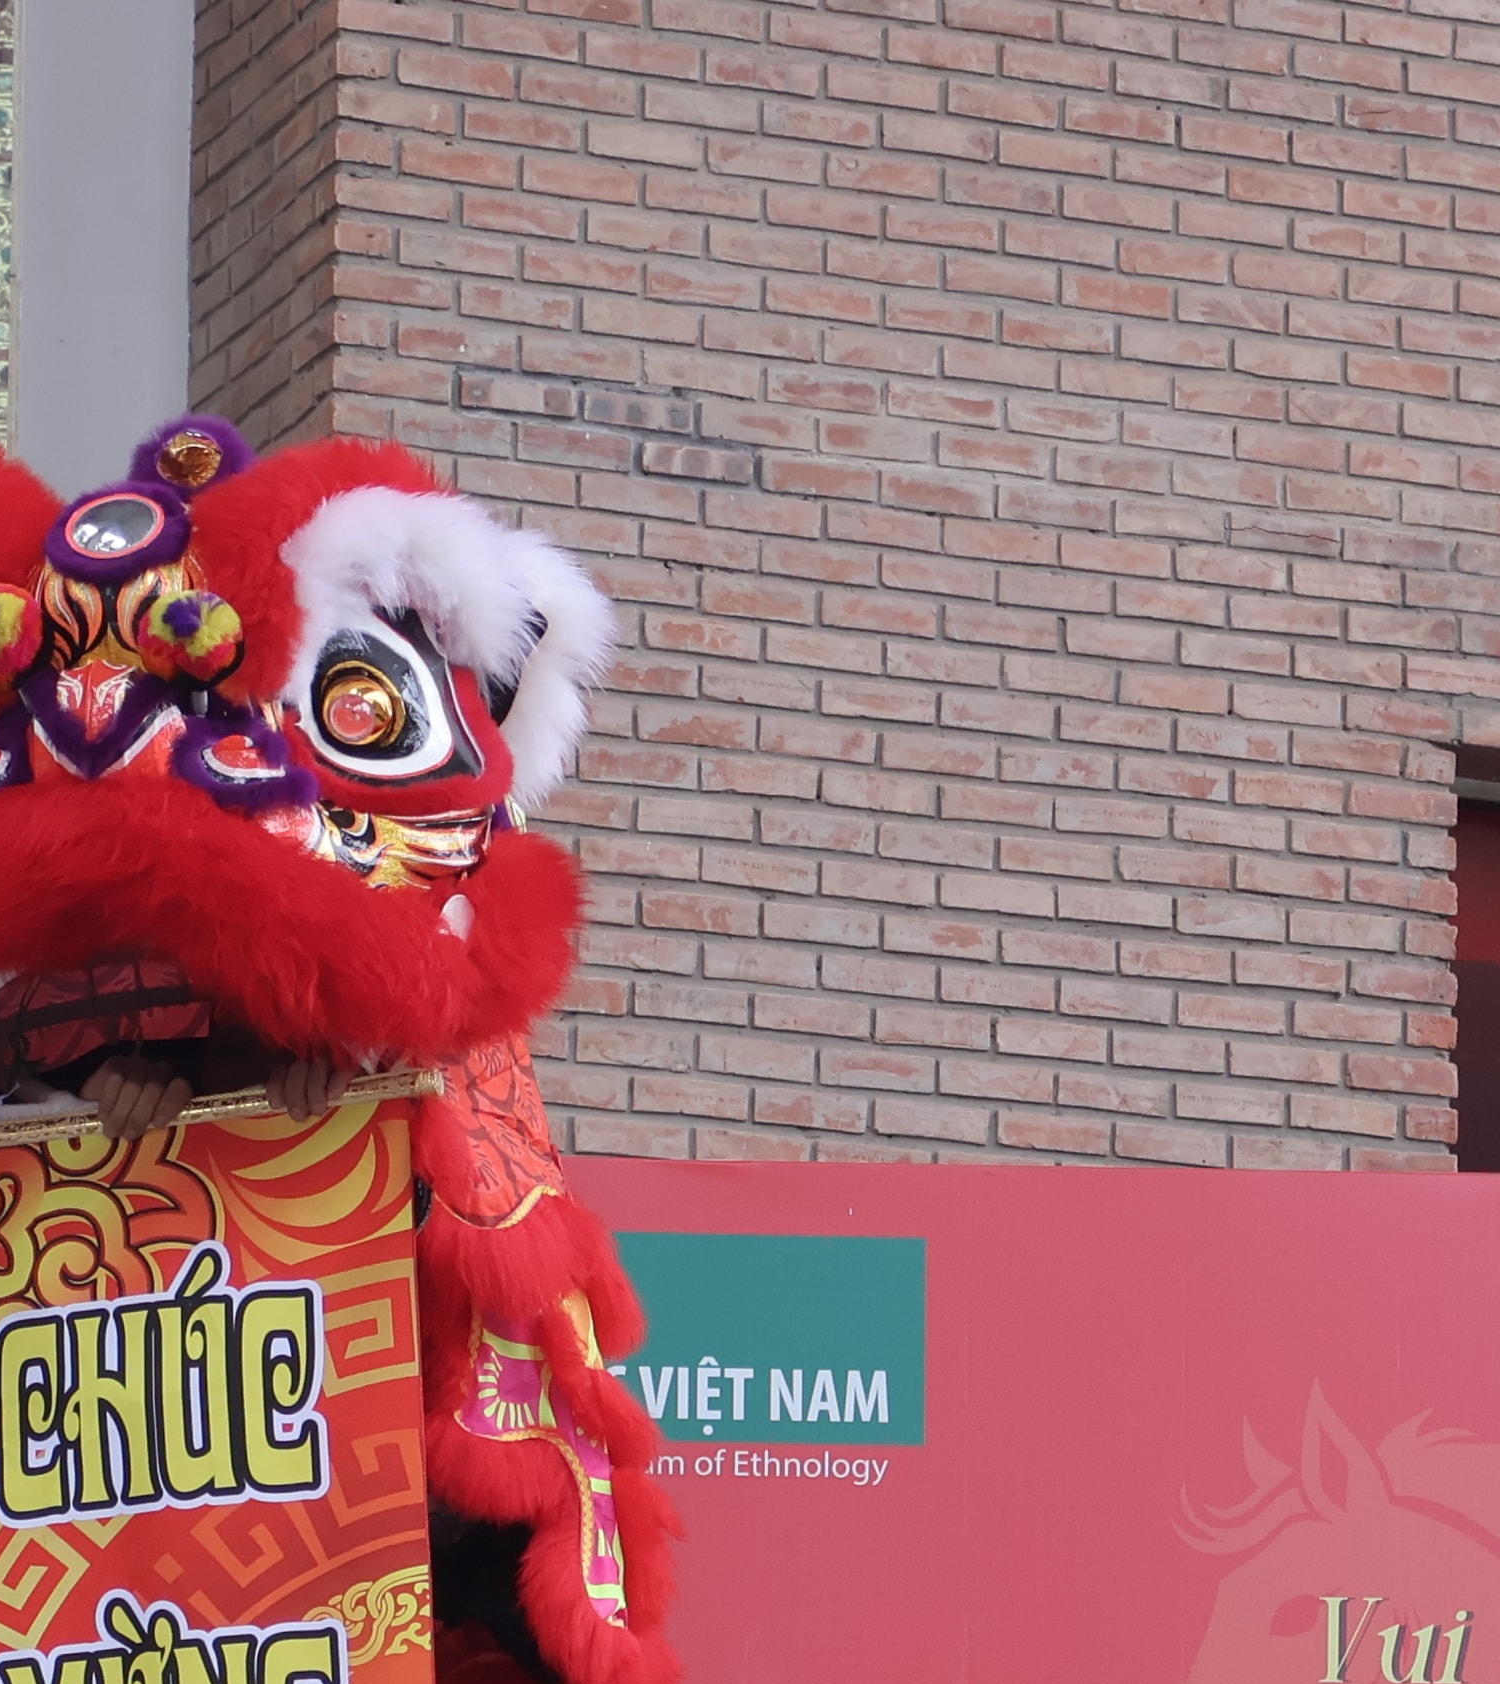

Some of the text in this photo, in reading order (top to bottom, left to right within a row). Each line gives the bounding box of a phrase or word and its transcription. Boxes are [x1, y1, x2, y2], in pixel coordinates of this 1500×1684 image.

[638, 1355, 889, 1436] VIỆT NAM
[693, 1448, 727, 1476] of
[733, 1449, 889, 1486] Ethnology
[1318, 1595, 1470, 1684] Vui
